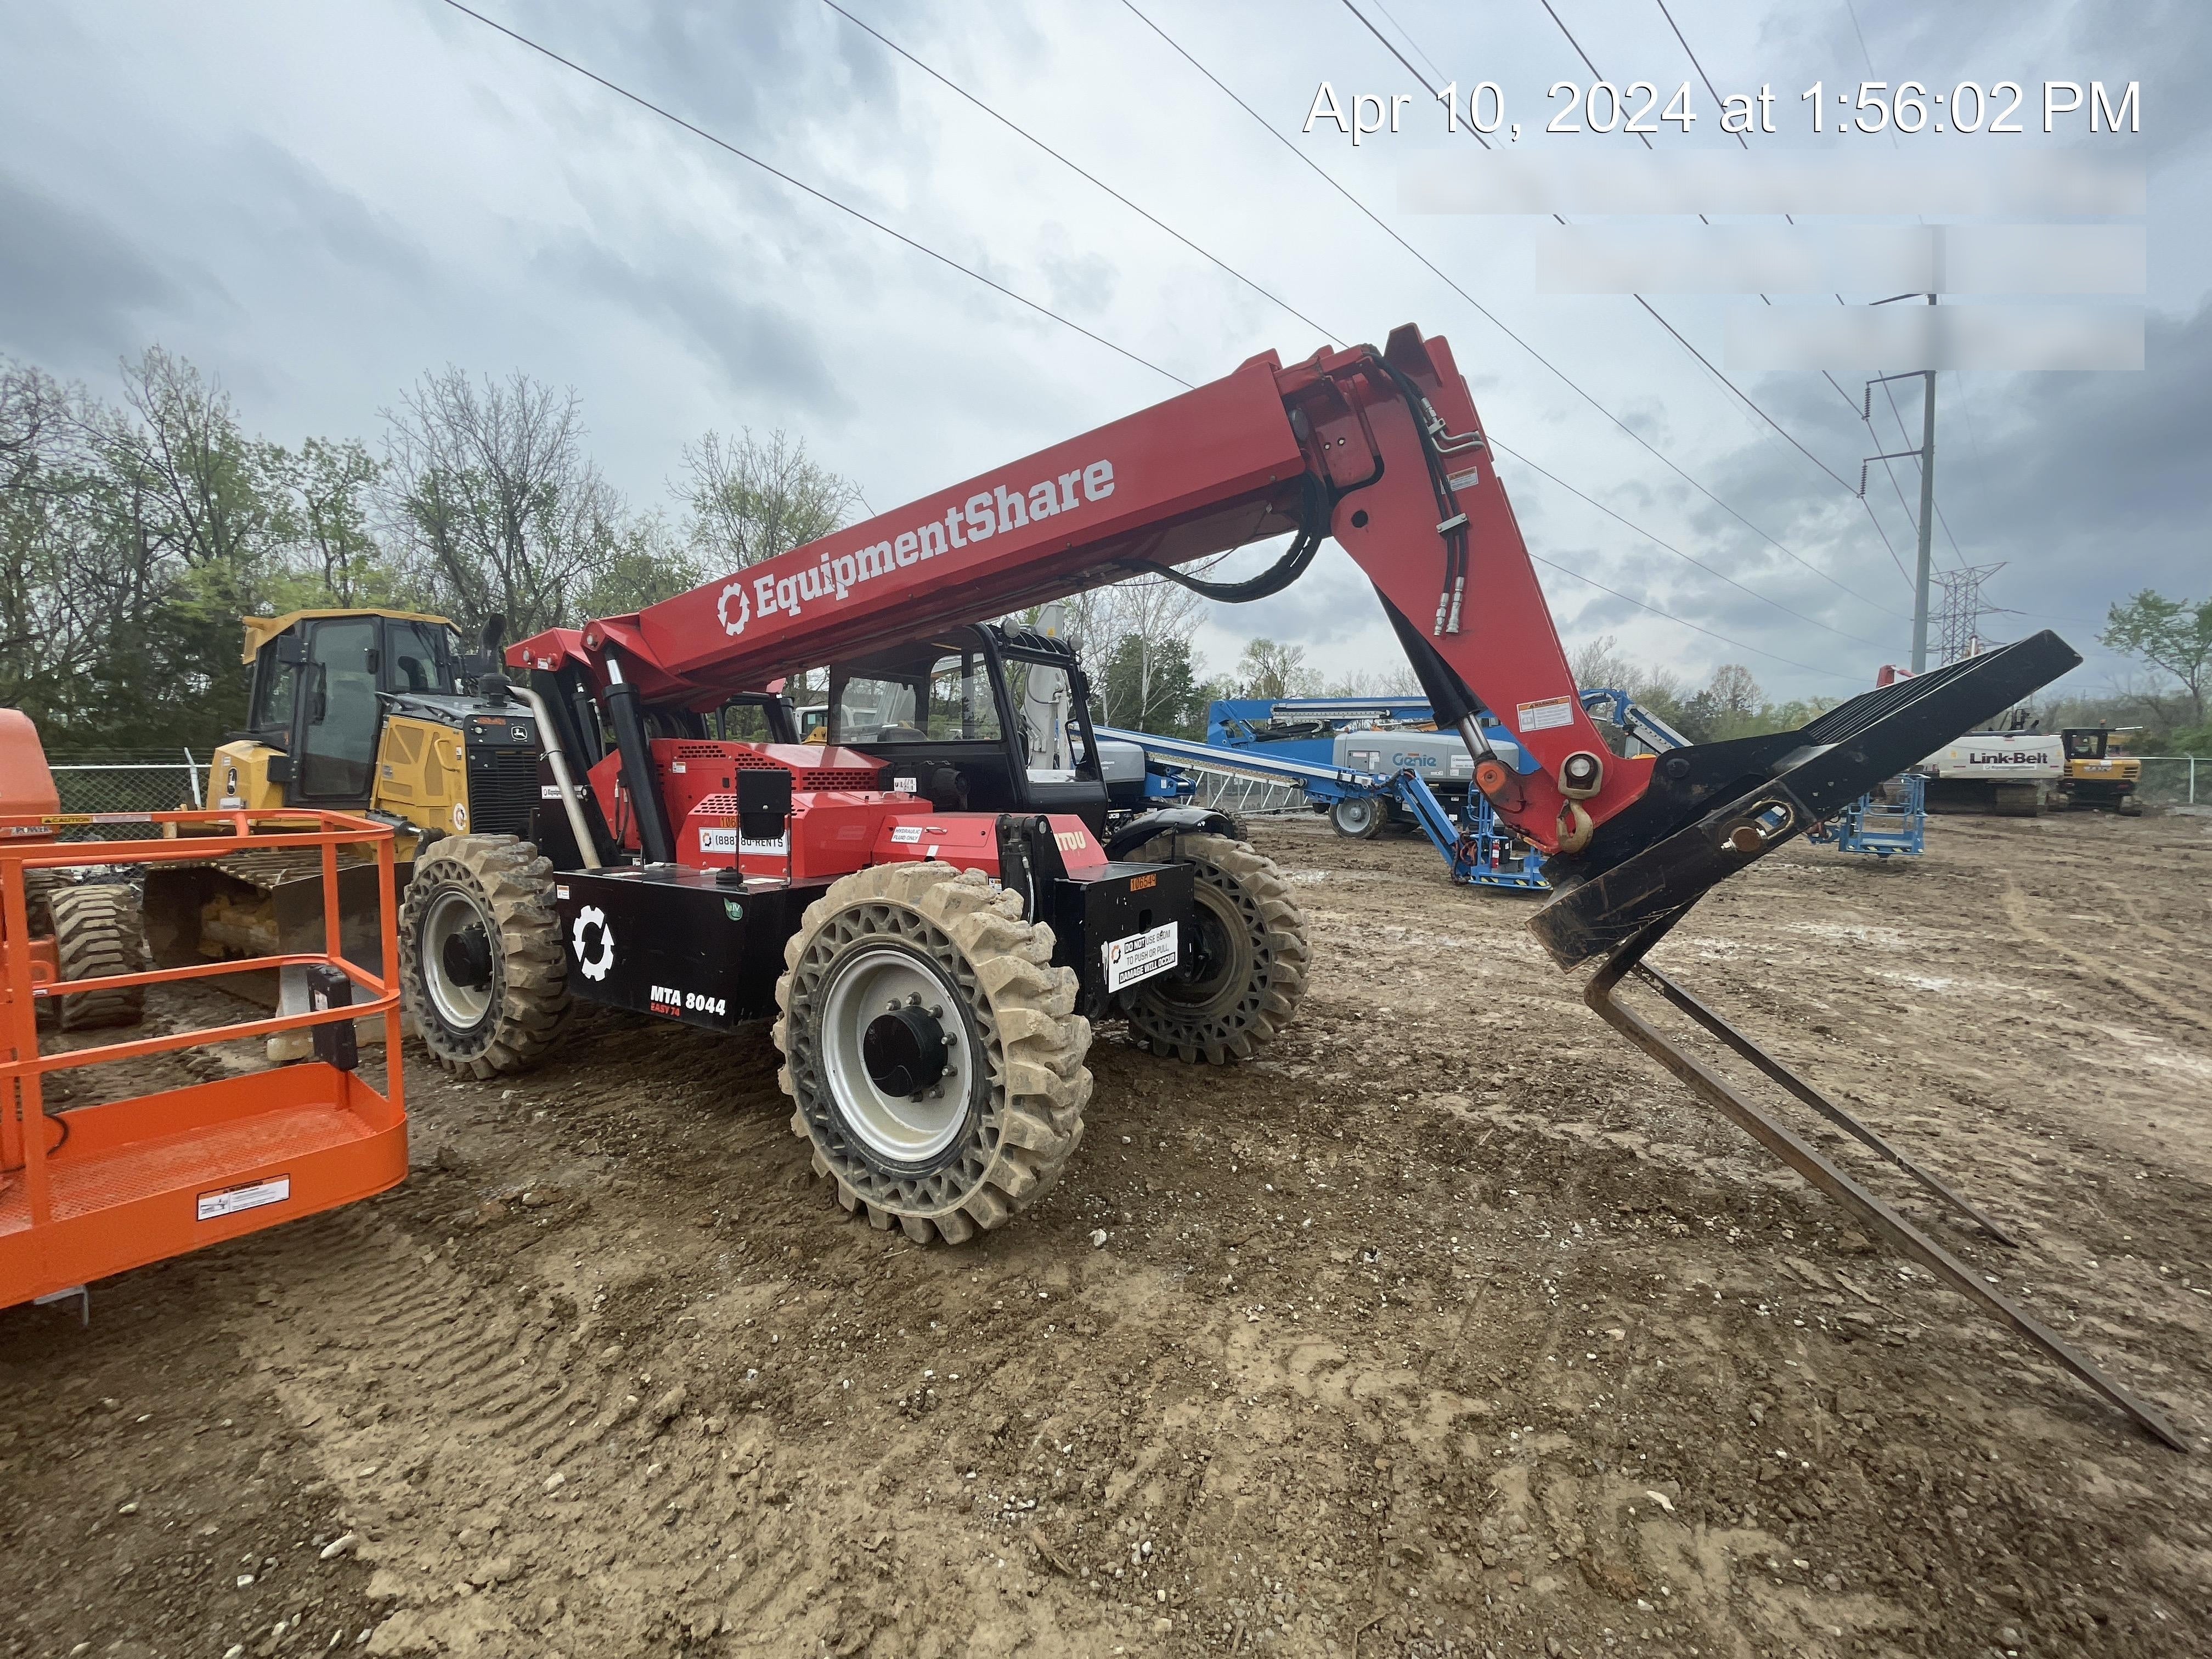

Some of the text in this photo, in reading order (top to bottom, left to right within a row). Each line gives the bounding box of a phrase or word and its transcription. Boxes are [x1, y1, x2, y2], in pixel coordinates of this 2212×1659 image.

[752, 459, 1116, 617] EquipmentShare
[1392, 752, 1437, 767] Genie
[1970, 752, 2048, 764] Link-Belt
[1125, 929, 1171, 953] DO NOT USE BOOM
[1126, 956, 1133, 966] TO
[1135, 952, 1148, 963] PUSH
[1149, 947, 1156, 957] OR
[1120, 953, 1175, 983] DAMAGE WILL OCCUR
[650, 985, 726, 1016] MTA 8044
[650, 1002, 680, 1017] EASY 74
